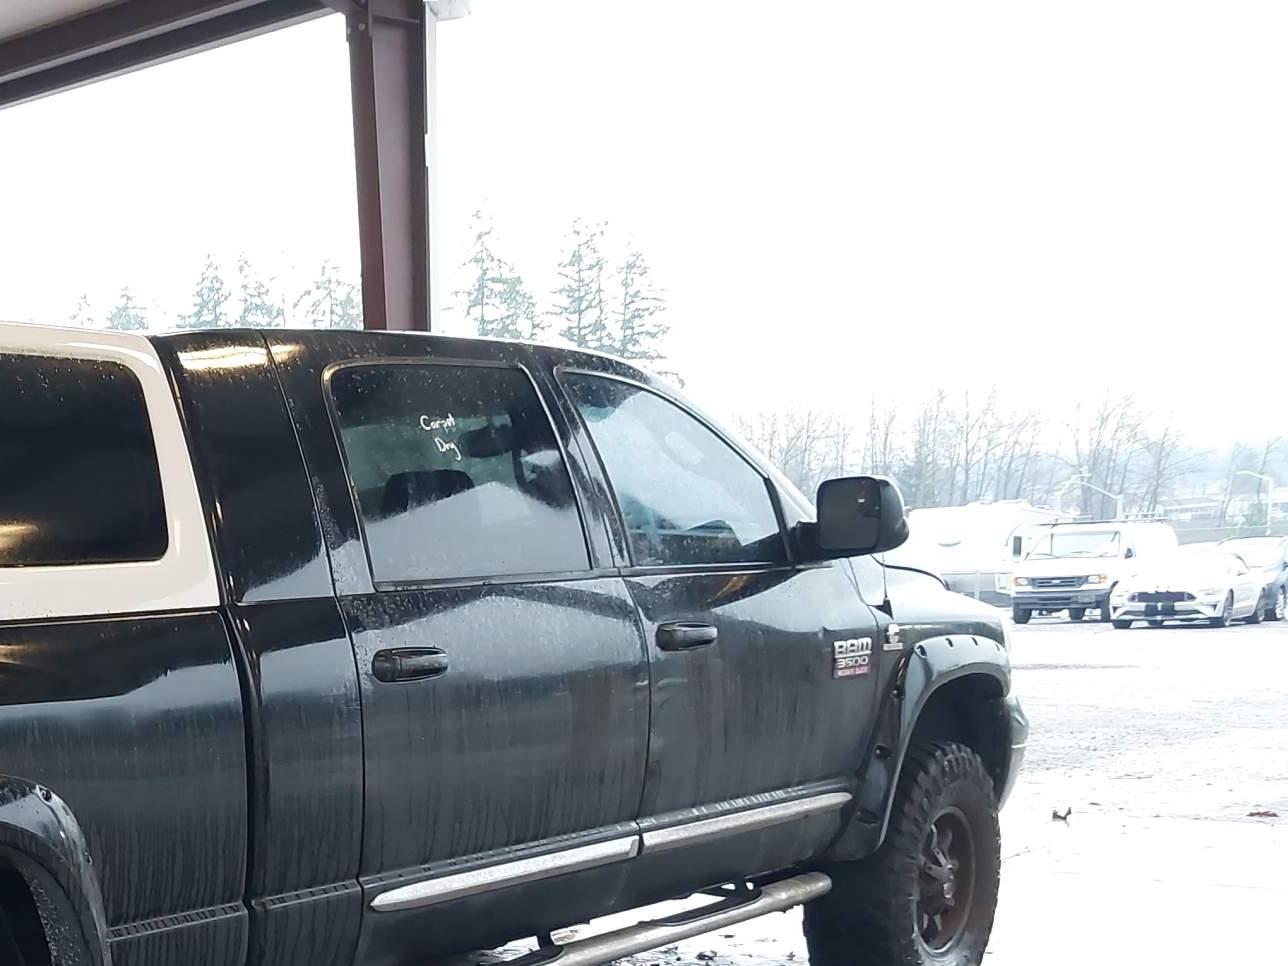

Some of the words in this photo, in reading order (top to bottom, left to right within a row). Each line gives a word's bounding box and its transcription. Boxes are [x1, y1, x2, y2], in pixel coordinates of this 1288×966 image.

[434, 436, 462, 461] Dry
[834, 637, 872, 655] RAM
[835, 656, 869, 669] 3500
